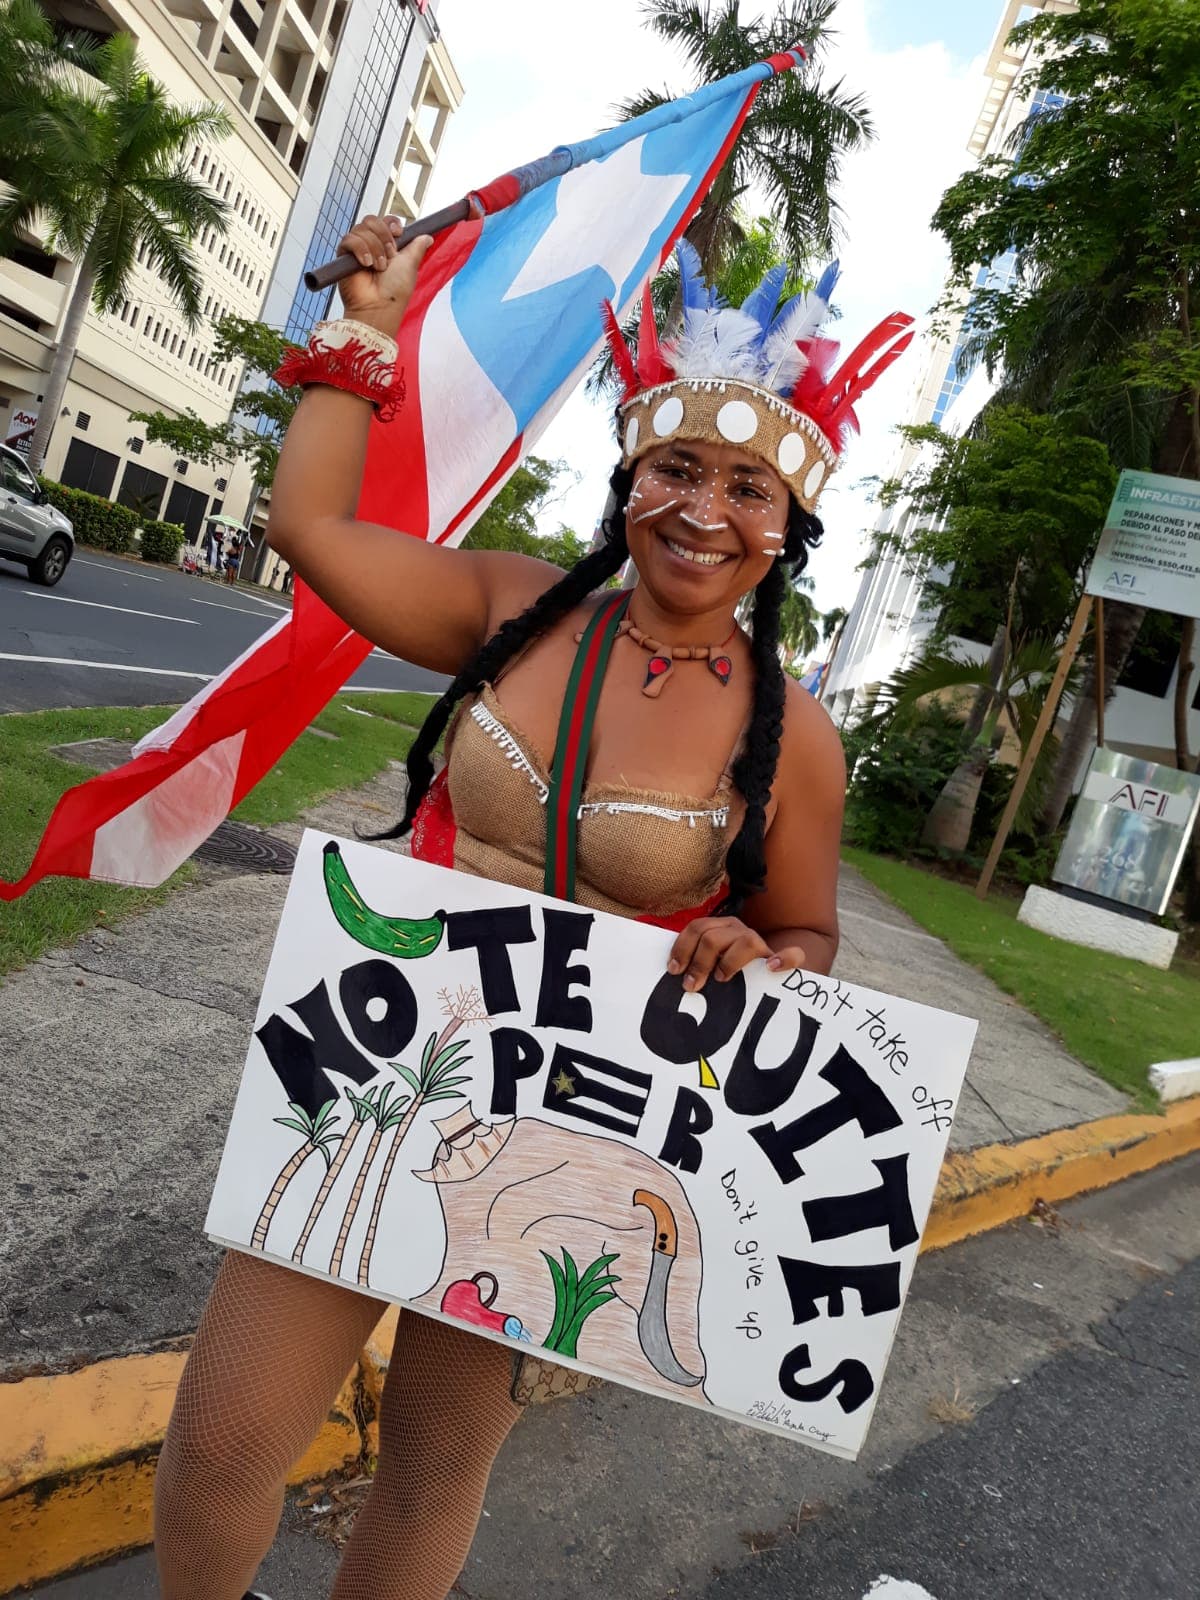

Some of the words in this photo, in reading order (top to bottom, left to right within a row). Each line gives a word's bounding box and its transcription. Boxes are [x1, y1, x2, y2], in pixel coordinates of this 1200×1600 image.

[1120, 519, 1150, 531] DEBIDO
[1152, 525, 1161, 533] AL
[1163, 526, 1186, 537] PASO
[1124, 509, 1185, 527] REPARACIONES
[1187, 520, 1193, 528] Y
[1106, 571, 1136, 588] AFI
[1109, 784, 1170, 817] AFI
[782, 968, 853, 1016] Don't
[856, 1008, 909, 1076] take
[912, 1086, 953, 1132] off
[255, 959, 418, 1120] NO
[446, 904, 596, 1033] TE
[640, 964, 919, 1414] QUITES
[721, 1168, 758, 1224] Don't
[735, 1239, 764, 1290] give
[735, 1311, 762, 1340] up
